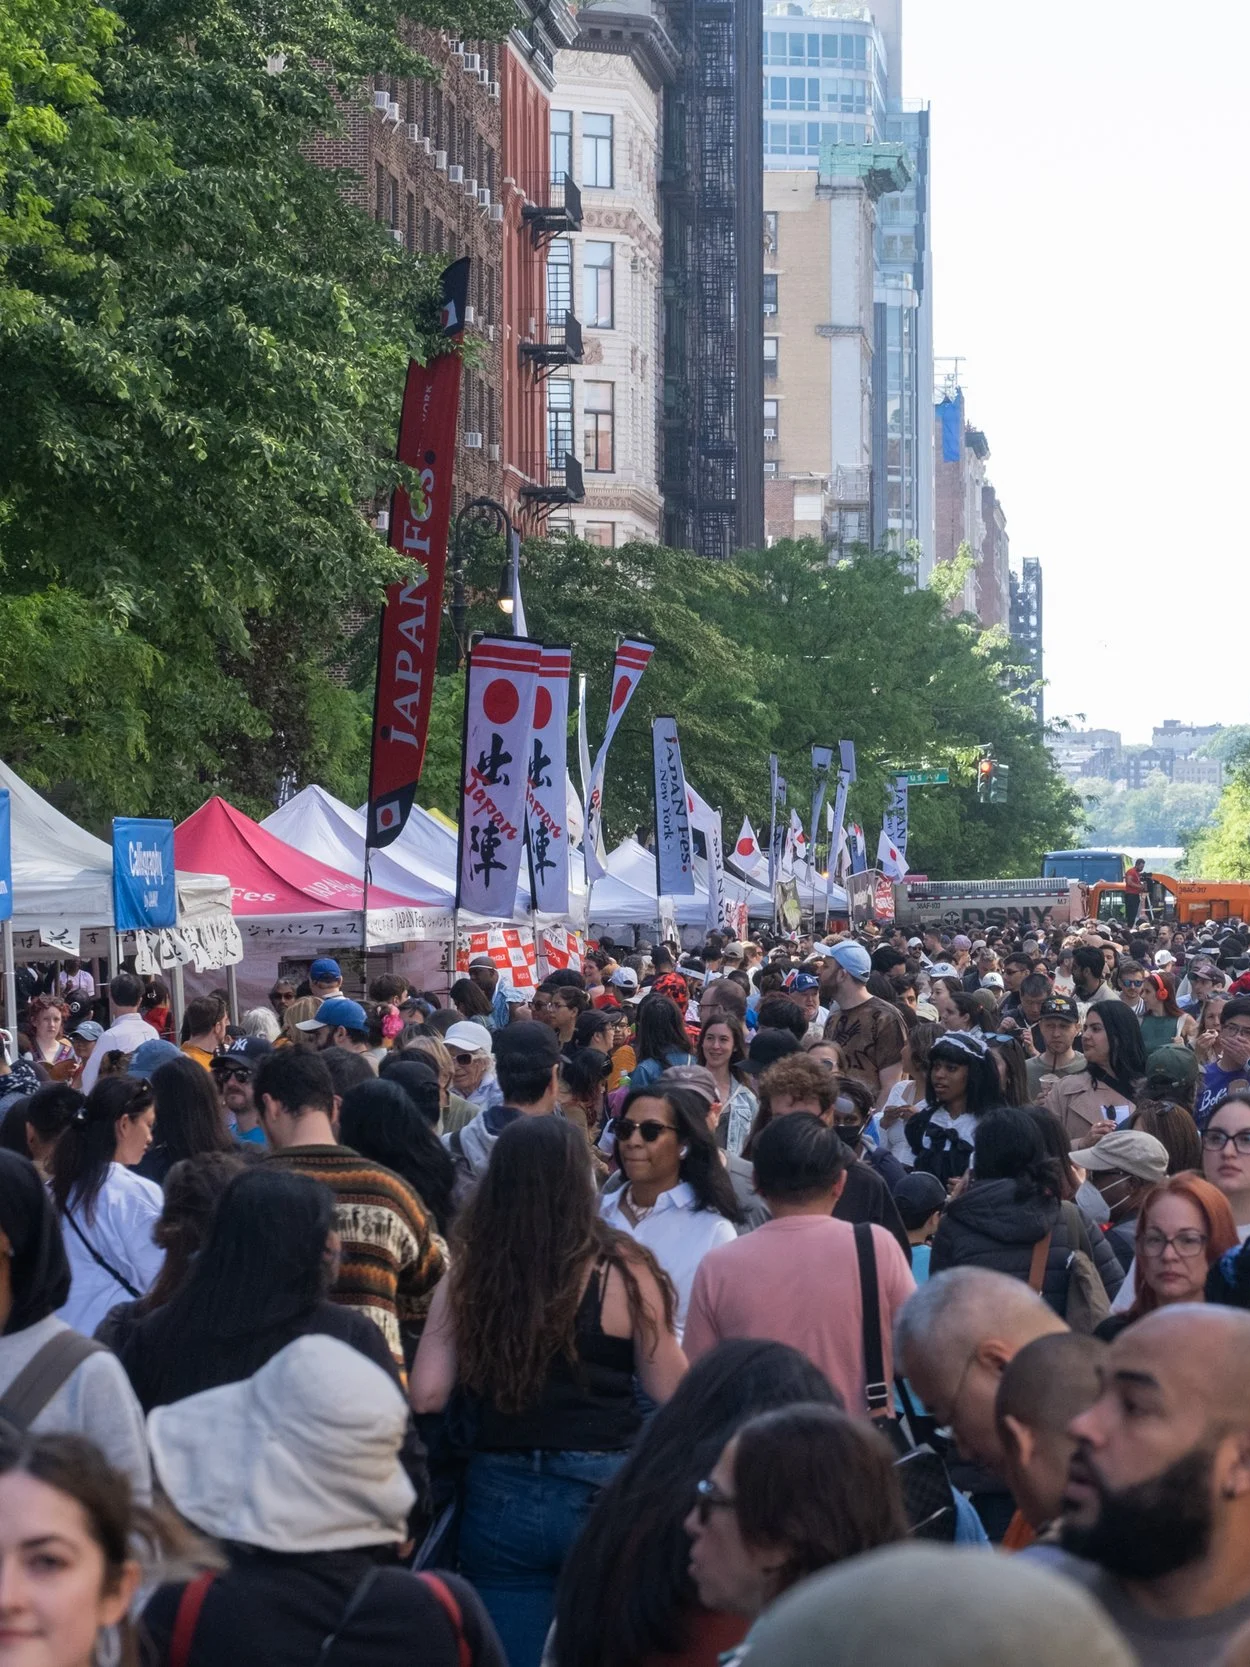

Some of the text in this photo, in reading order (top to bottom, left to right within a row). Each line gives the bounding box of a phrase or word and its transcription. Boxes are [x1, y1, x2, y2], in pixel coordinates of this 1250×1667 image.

[660, 769, 669, 800] New
[664, 736, 687, 817] JAPAN
[464, 766, 518, 841] Japan
[663, 805, 675, 841] York
[248, 923, 358, 937] ジャパンフェス
[962, 905, 1053, 925] DSNY
